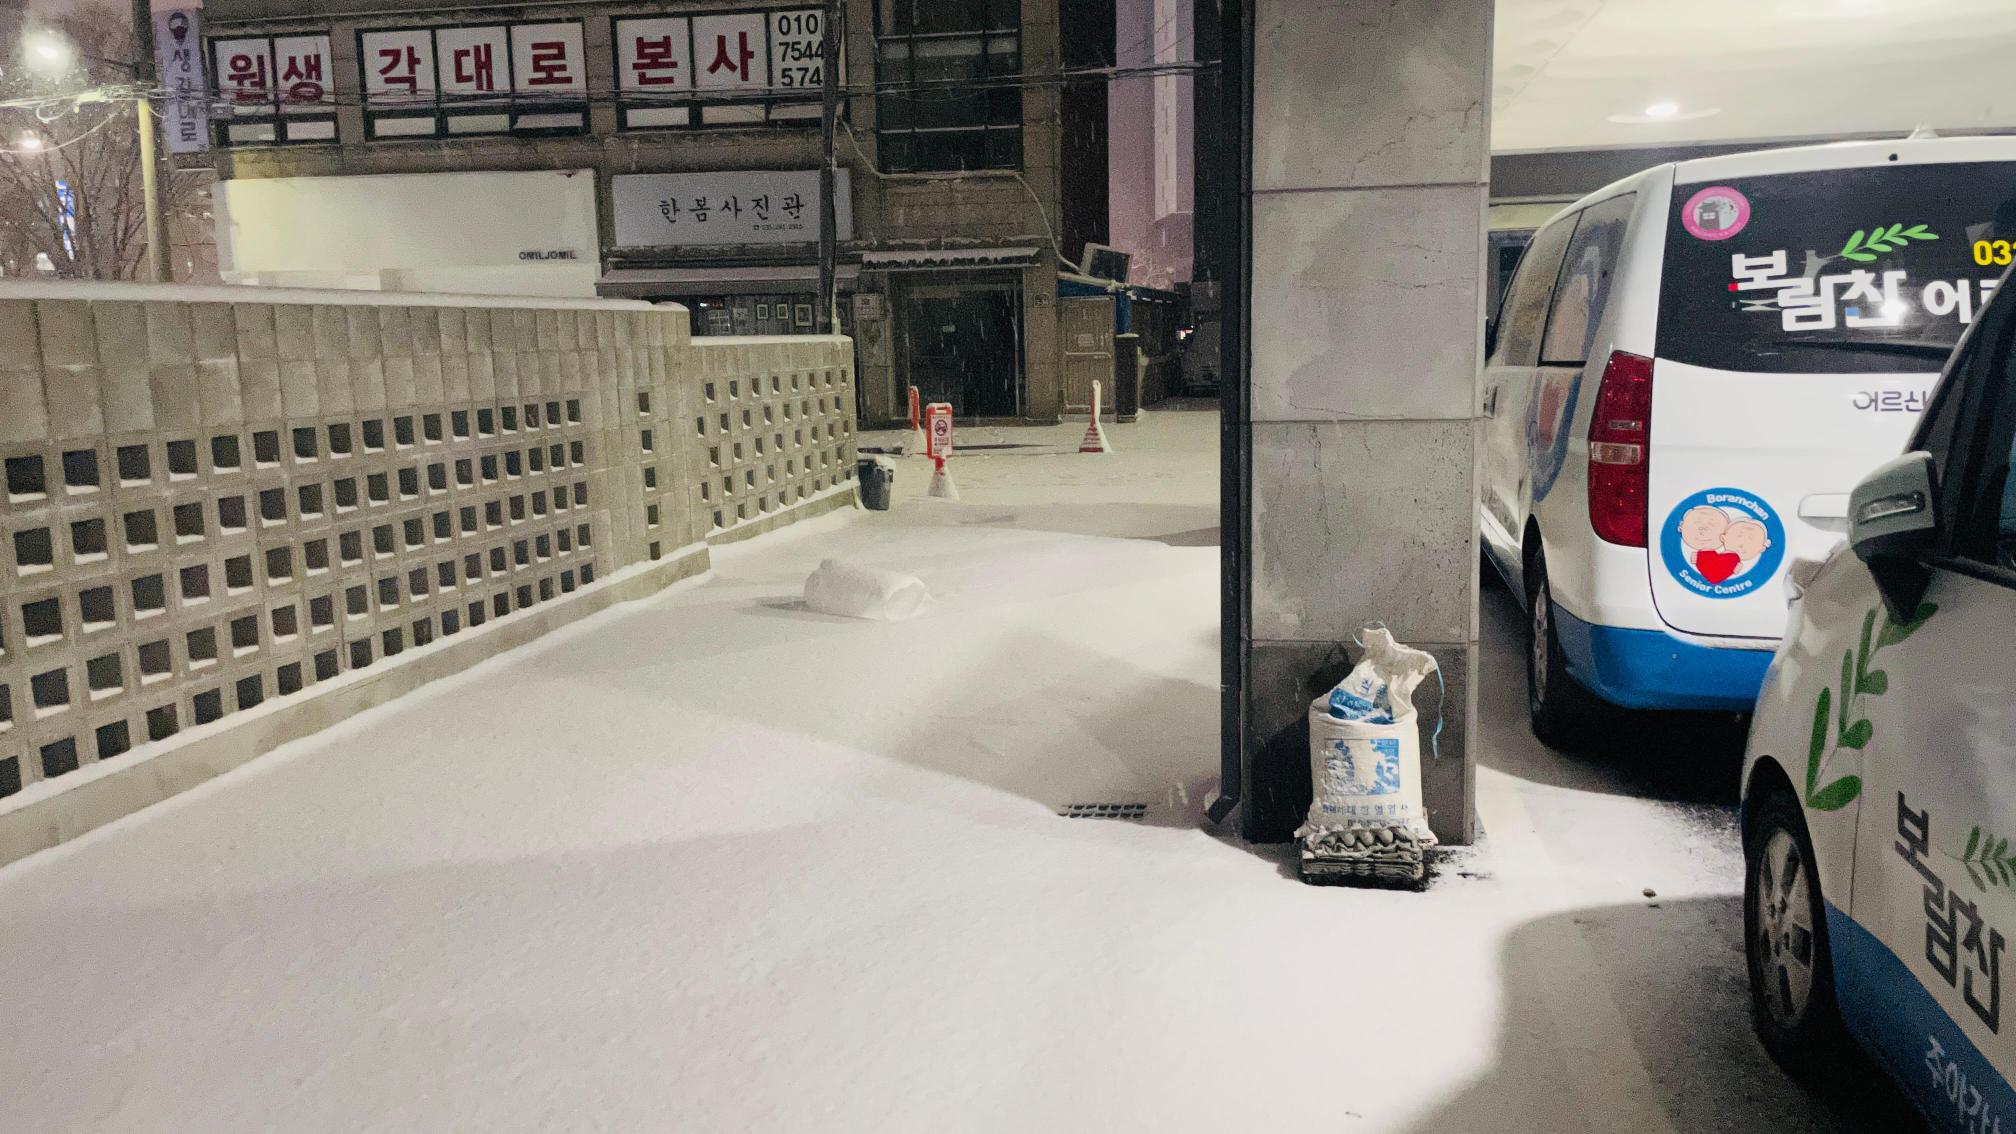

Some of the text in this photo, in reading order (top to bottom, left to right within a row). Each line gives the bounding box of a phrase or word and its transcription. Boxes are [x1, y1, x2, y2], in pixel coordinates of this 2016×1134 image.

[778, 13, 819, 35] 010
[779, 40, 825, 62] 7544
[1706, 493, 1770, 520] Boramchan
[1679, 569, 1753, 594] Senior Centre
[1895, 791, 2006, 1036] 보람찬
